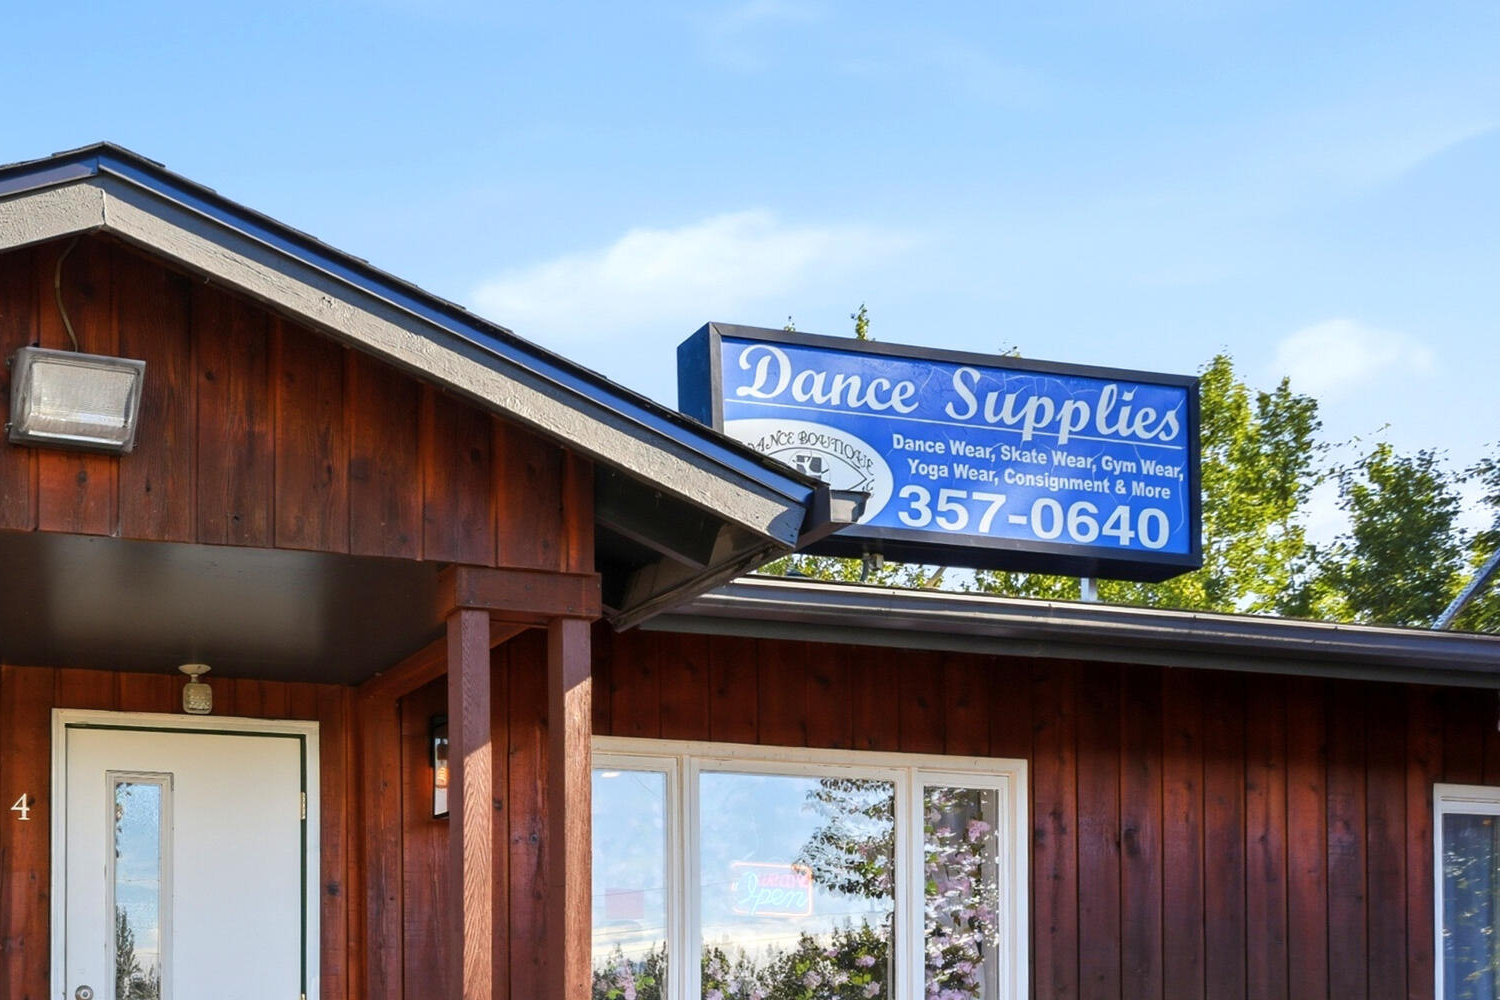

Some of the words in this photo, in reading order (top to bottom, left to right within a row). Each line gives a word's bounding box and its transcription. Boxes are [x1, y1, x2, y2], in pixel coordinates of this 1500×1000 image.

[736, 344, 919, 414] Dance
[944, 366, 1181, 446] Supplies
[797, 430, 875, 476] BOUTIQUE
[892, 433, 946, 454] Dance
[949, 439, 997, 462] Wear,
[1000, 444, 1048, 465] Skate
[1051, 450, 1097, 473] Wear,
[1101, 455, 1138, 475] Gym
[1140, 459, 1185, 482] Wear,
[906, 457, 949, 480] Yoga
[953, 462, 999, 487] Wear,
[1003, 467, 1111, 493] Consignment
[1114, 479, 1127, 495] &
[1131, 480, 1172, 500] More
[897, 484, 1171, 550] 357-0640
[10, 792, 31, 821] 4
